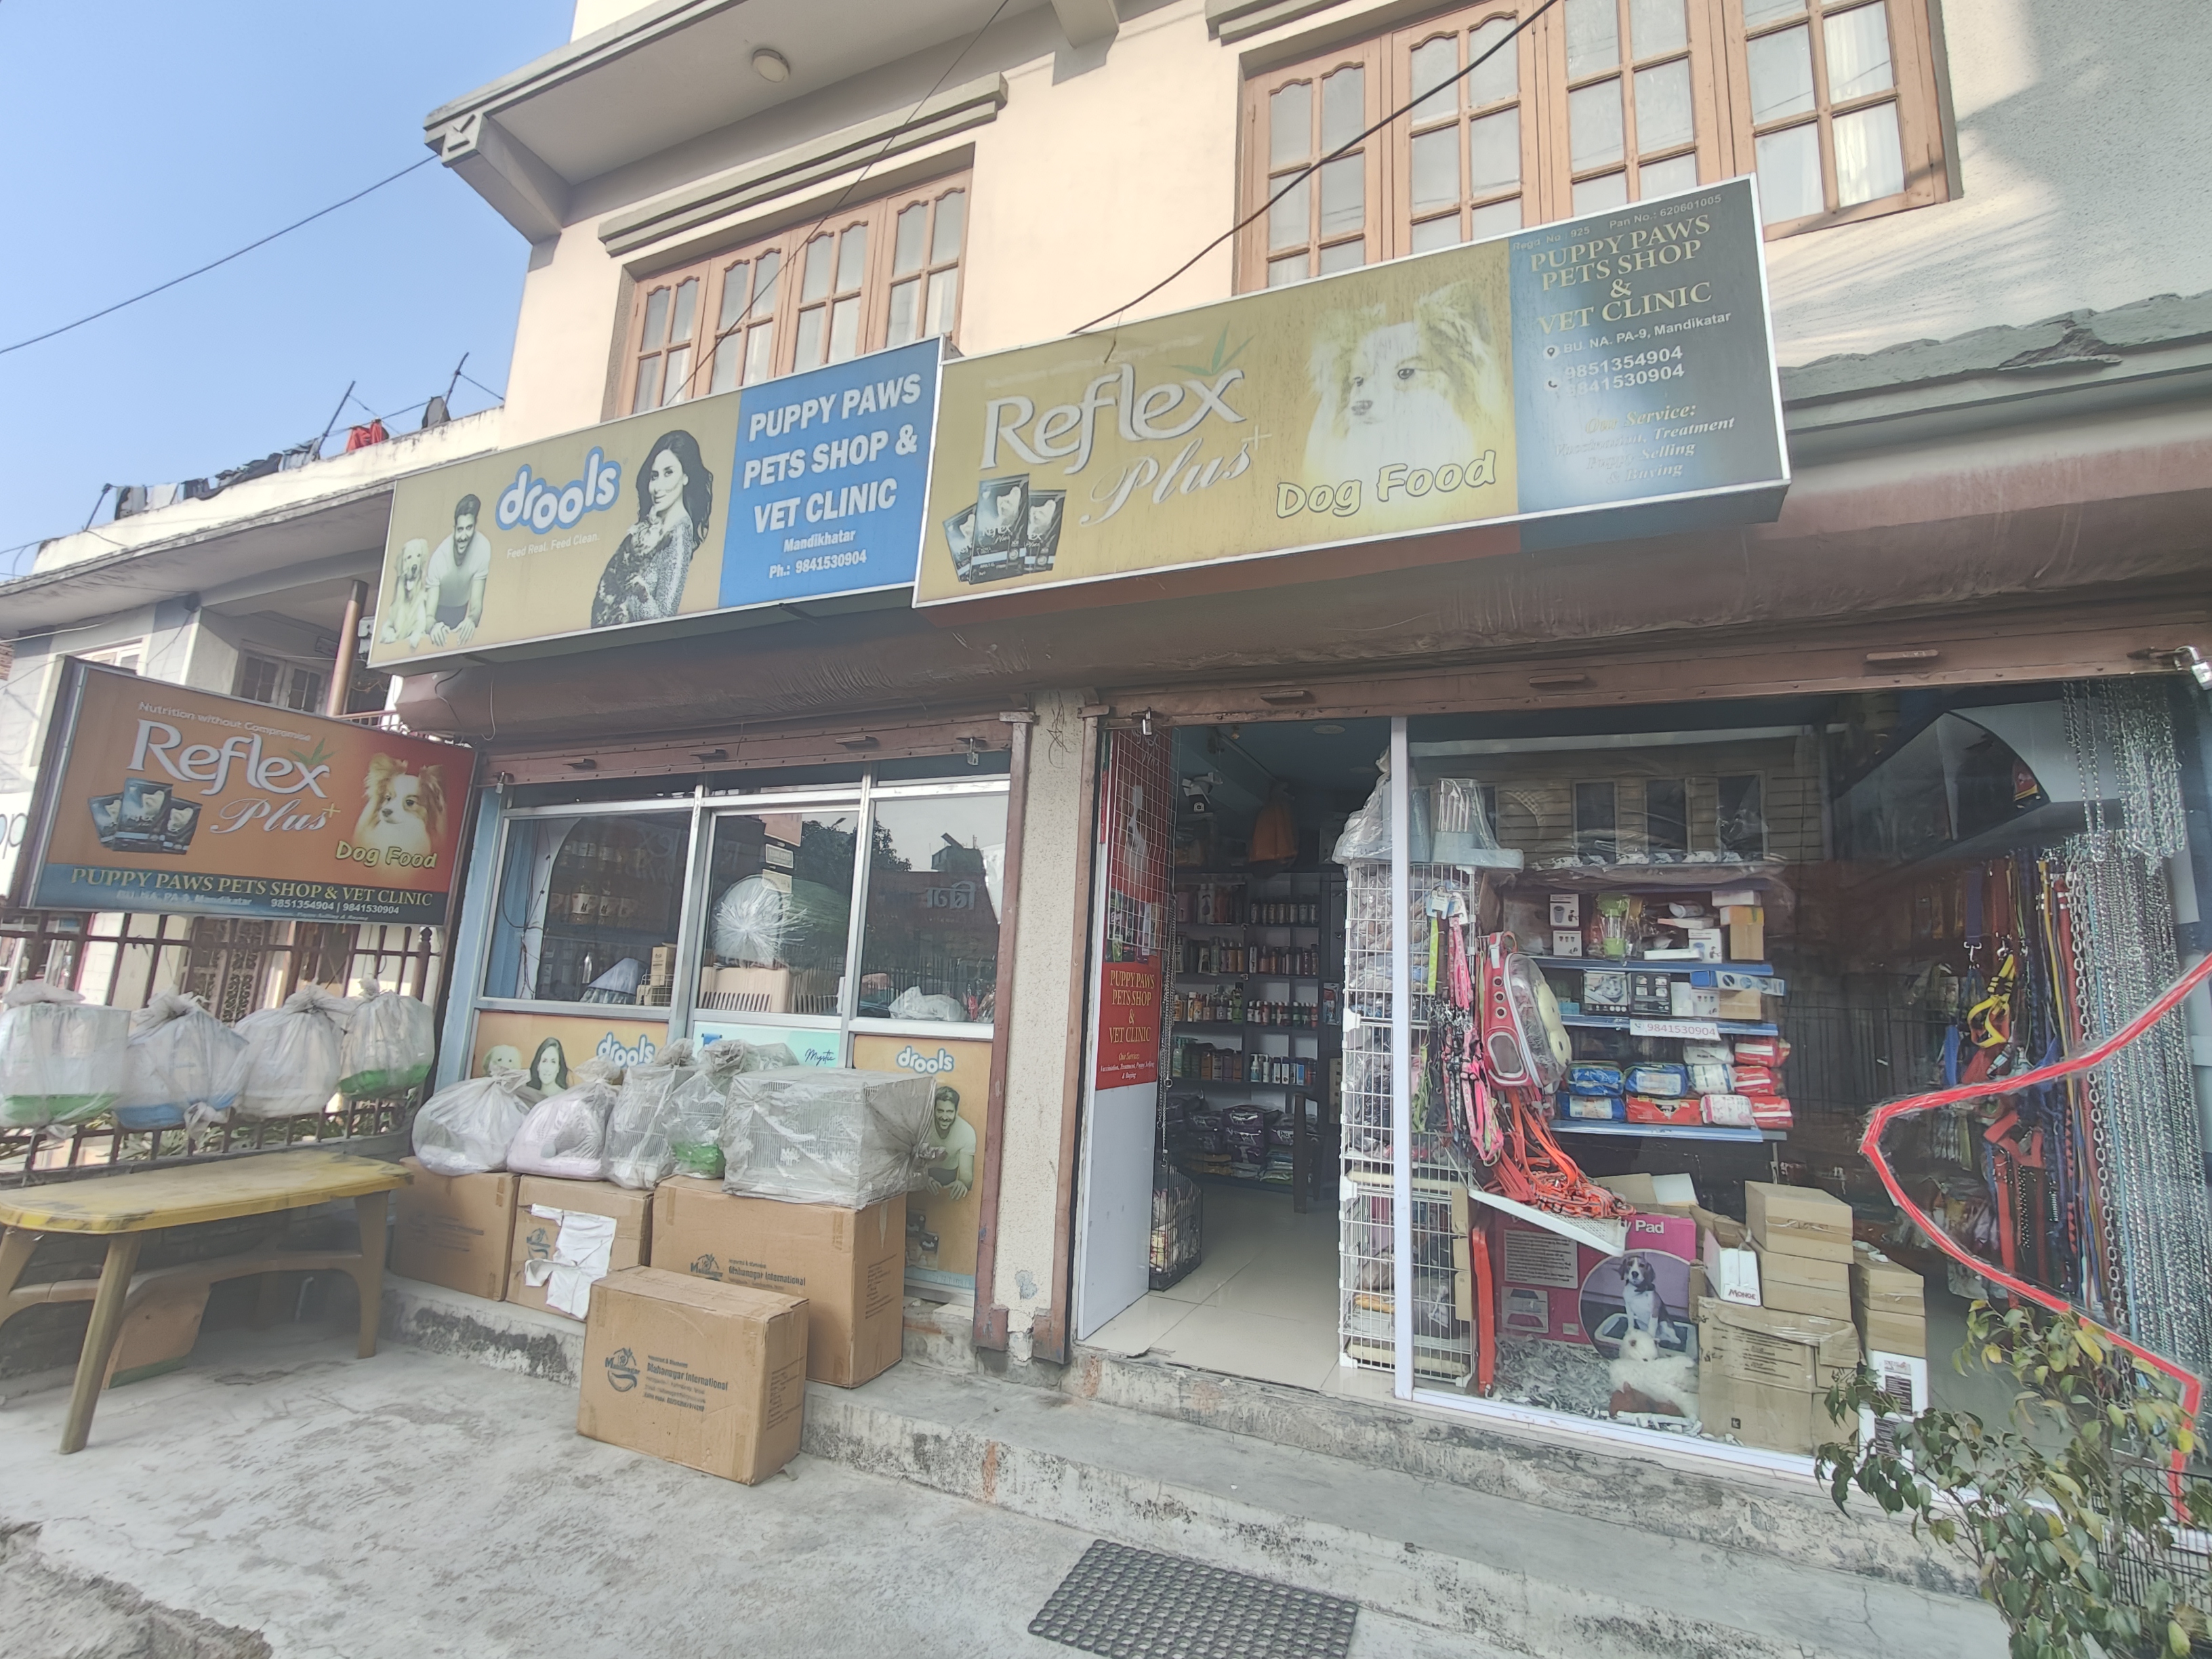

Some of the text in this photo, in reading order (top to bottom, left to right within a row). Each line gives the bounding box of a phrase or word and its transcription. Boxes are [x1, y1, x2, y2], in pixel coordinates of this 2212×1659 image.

[1609, 218, 1631, 230] Pan
[1660, 194, 1722, 218] 620601005
[1530, 214, 1711, 272] PUPPY PAWS
[1570, 226, 1591, 239] 925
[1542, 239, 1702, 291] PETS SHOP
[1610, 278, 1633, 299] &
[1537, 281, 1712, 335] VET CLINIC
[1590, 335, 1613, 350] NA.
[1617, 329, 1651, 343] PA-9,
[1654, 313, 1732, 336] Mandikatar
[1565, 345, 1683, 380] 9851354904
[748, 373, 922, 442] PUPPY PAWS
[980, 365, 1248, 476] Reflex
[1585, 404, 1697, 434] Our Service:
[1654, 416, 1736, 441] Treatment
[743, 424, 918, 489] PETS SHOP &
[1639, 443, 1696, 462] Selling
[498, 447, 620, 533] drools
[1276, 449, 1497, 518] Dog Food
[754, 477, 899, 534] VET CLINIC
[506, 546, 527, 559] Feed
[550, 536, 572, 550] Feed
[783, 527, 857, 554] Mandikhatar
[796, 550, 867, 574] 9841530904
[138, 701, 311, 741] Nutrition without Compromise
[126, 719, 331, 799] Reflex
[336, 840, 438, 869] Dog Food
[70, 867, 433, 907] PUPPY PAWS PETS SHOP & VET CLINIC
[271, 898, 335, 911] 9851354904
[342, 902, 399, 914] 9841530904
[1110, 969, 1155, 989] PUPPY PAWS
[1112, 989, 1151, 1006] PETS SHOP
[1128, 1008, 1135, 1025] &
[1647, 1023, 1716, 1037] 9841530904
[597, 1031, 655, 1067] drools
[1109, 1027, 1151, 1044] VET CLINIC
[804, 1048, 836, 1067] Mystic
[897, 1045, 955, 1073] drools
[1635, 1220, 1665, 1234] Pad
[765, 1271, 806, 1286] International
[647, 1362, 684, 1380] Mahanagar
[685, 1373, 729, 1392] International
